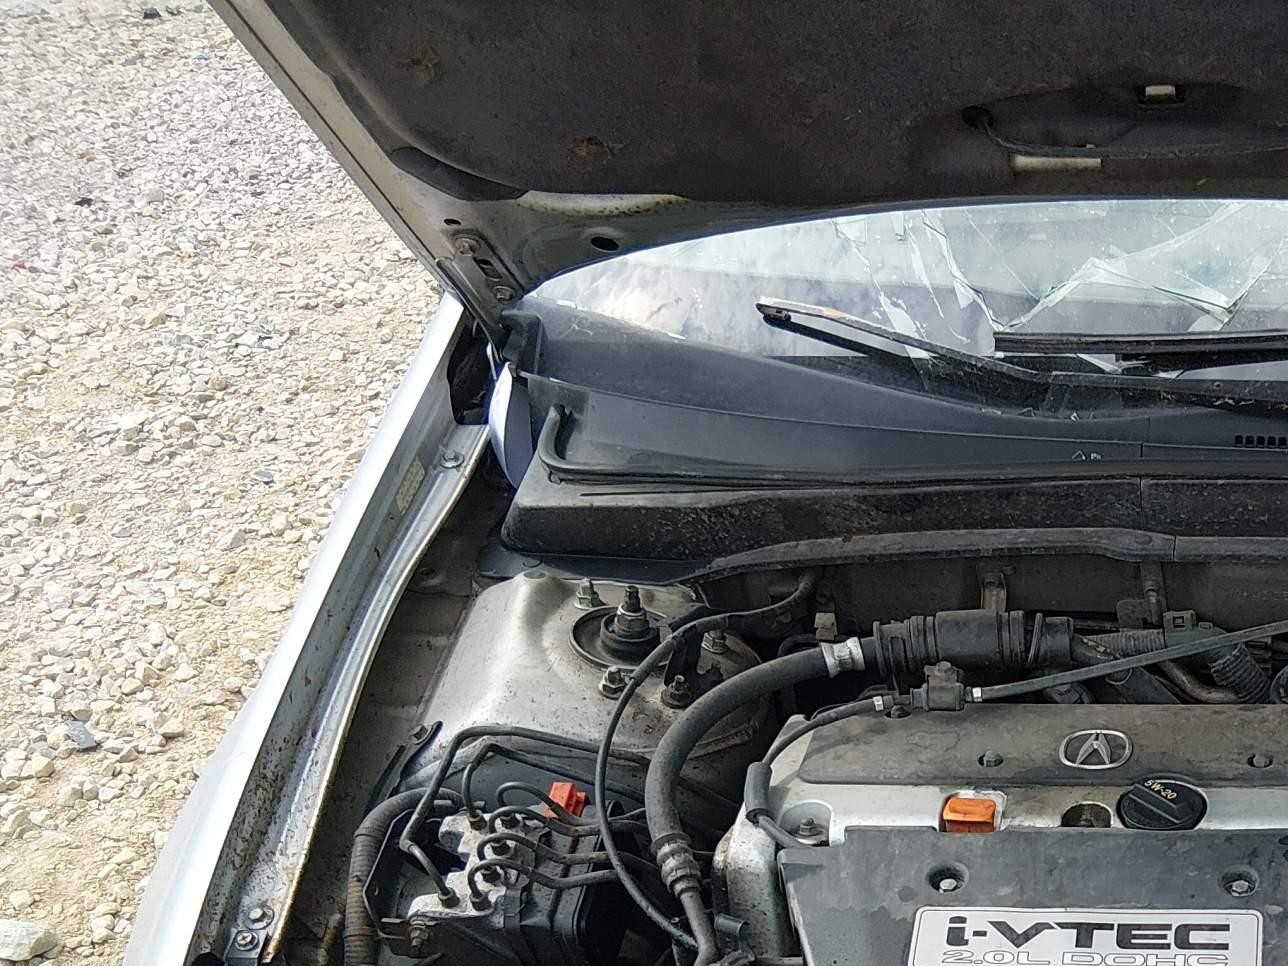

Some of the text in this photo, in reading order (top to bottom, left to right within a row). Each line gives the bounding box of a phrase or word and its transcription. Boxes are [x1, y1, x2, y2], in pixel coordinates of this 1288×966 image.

[1144, 779, 1177, 799] 5W-20
[946, 916, 1230, 949] i-VTEC
[941, 950, 1050, 965] 2.0L
